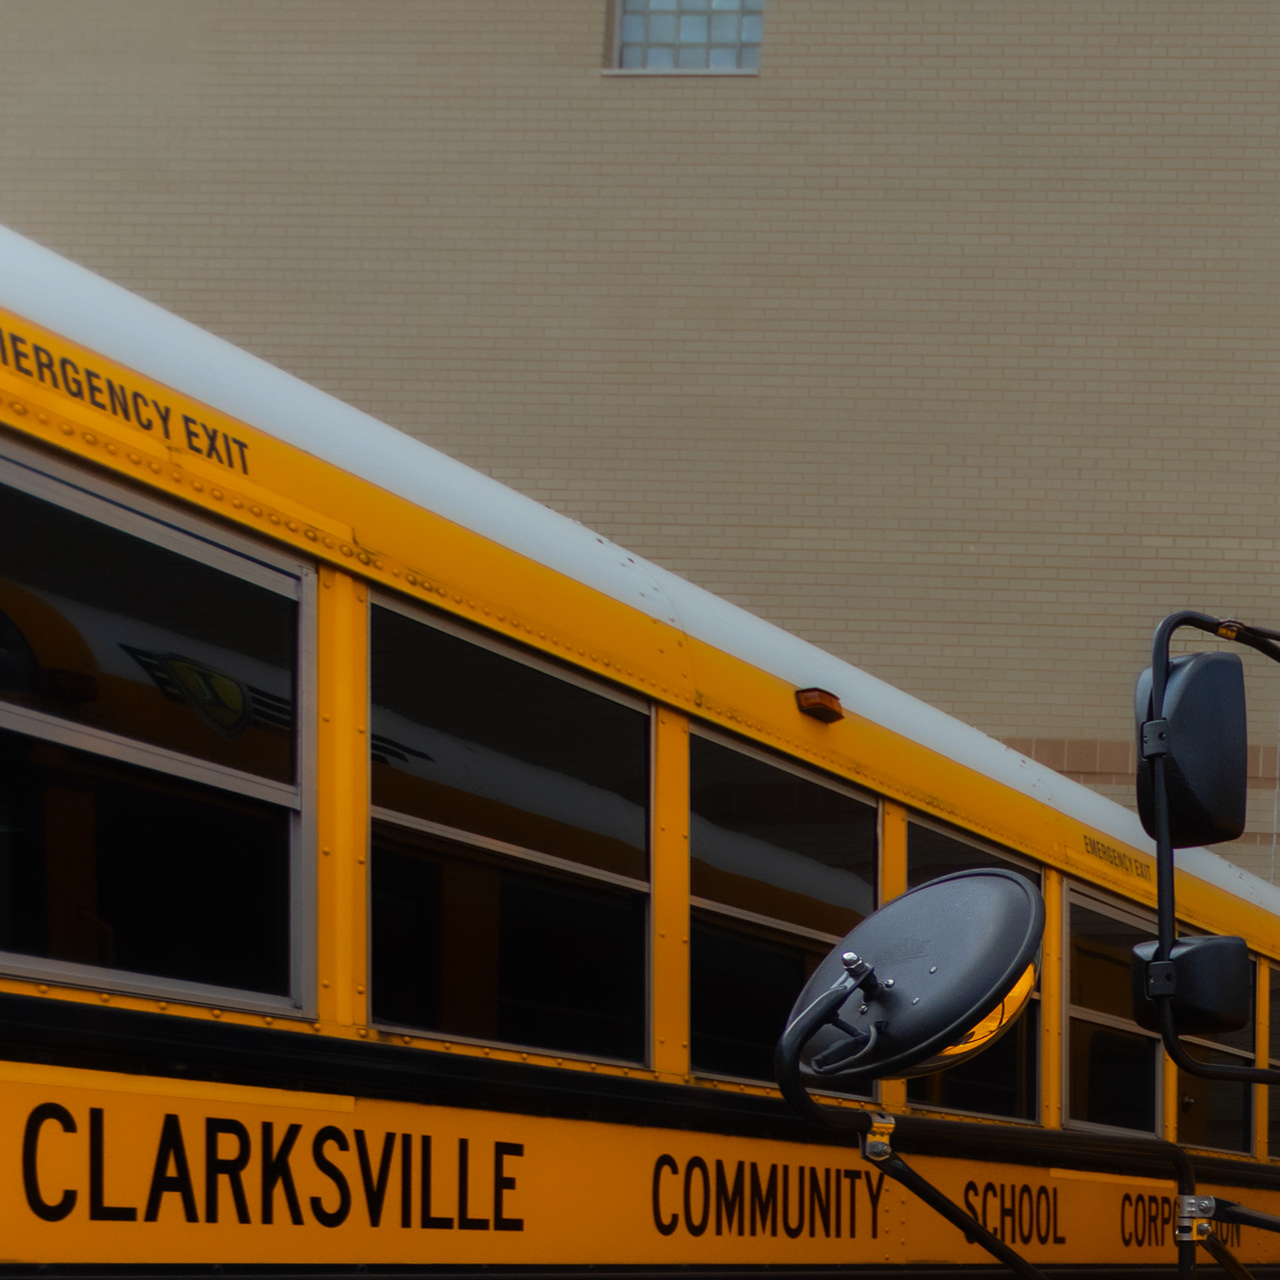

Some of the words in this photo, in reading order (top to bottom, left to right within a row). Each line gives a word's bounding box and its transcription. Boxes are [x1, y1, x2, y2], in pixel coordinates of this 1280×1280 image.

[0, 327, 171, 440] ERGENCY
[182, 414, 249, 475] EXIT
[1083, 835, 1133, 873] EMERGENCY
[1134, 859, 1152, 881] EXIT
[22, 1102, 525, 1232] CLARKSVILLE
[652, 1153, 885, 1240] COMMUNITY
[963, 1180, 1066, 1247] SCHOOL
